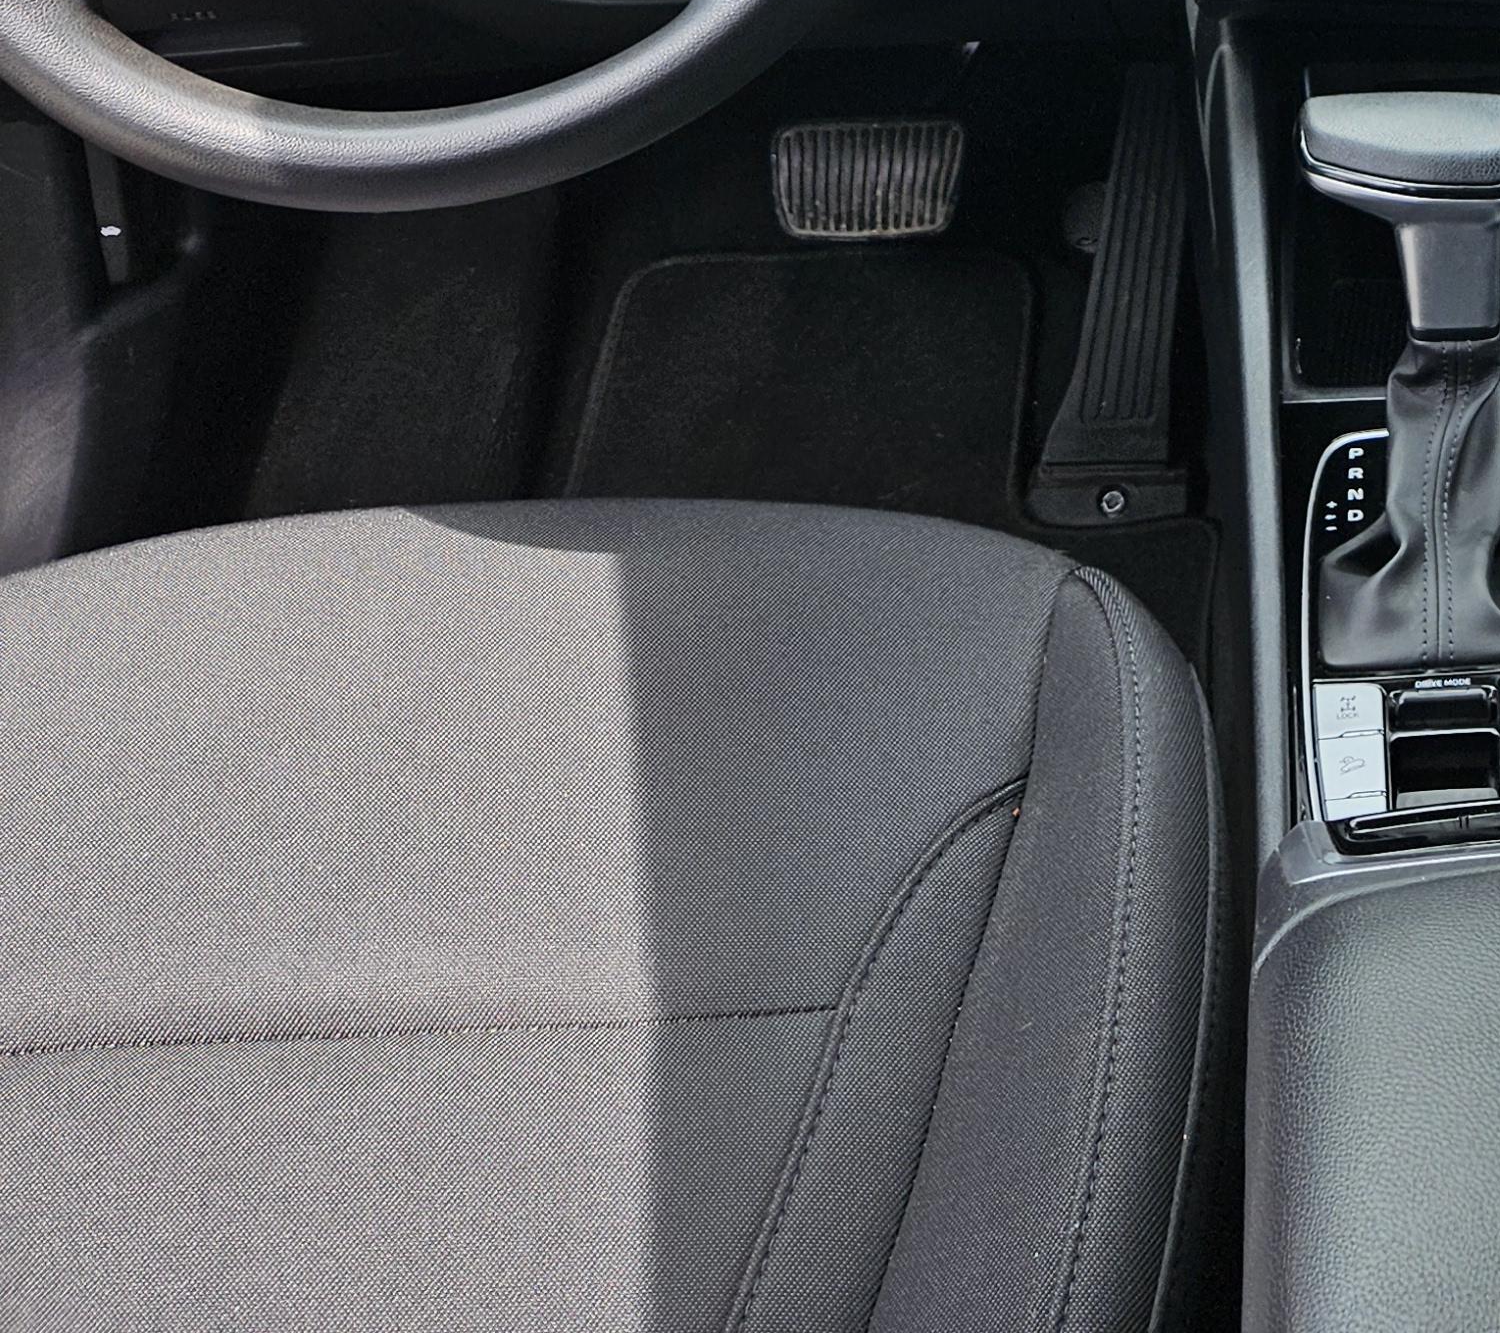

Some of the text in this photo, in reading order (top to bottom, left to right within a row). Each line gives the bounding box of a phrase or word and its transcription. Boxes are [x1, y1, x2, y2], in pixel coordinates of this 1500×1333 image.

[1348, 447, 1365, 460] P
[1348, 467, 1364, 480] R
[1347, 487, 1364, 501] N
[1347, 509, 1364, 522] D
[1443, 678, 1471, 687] MODE
